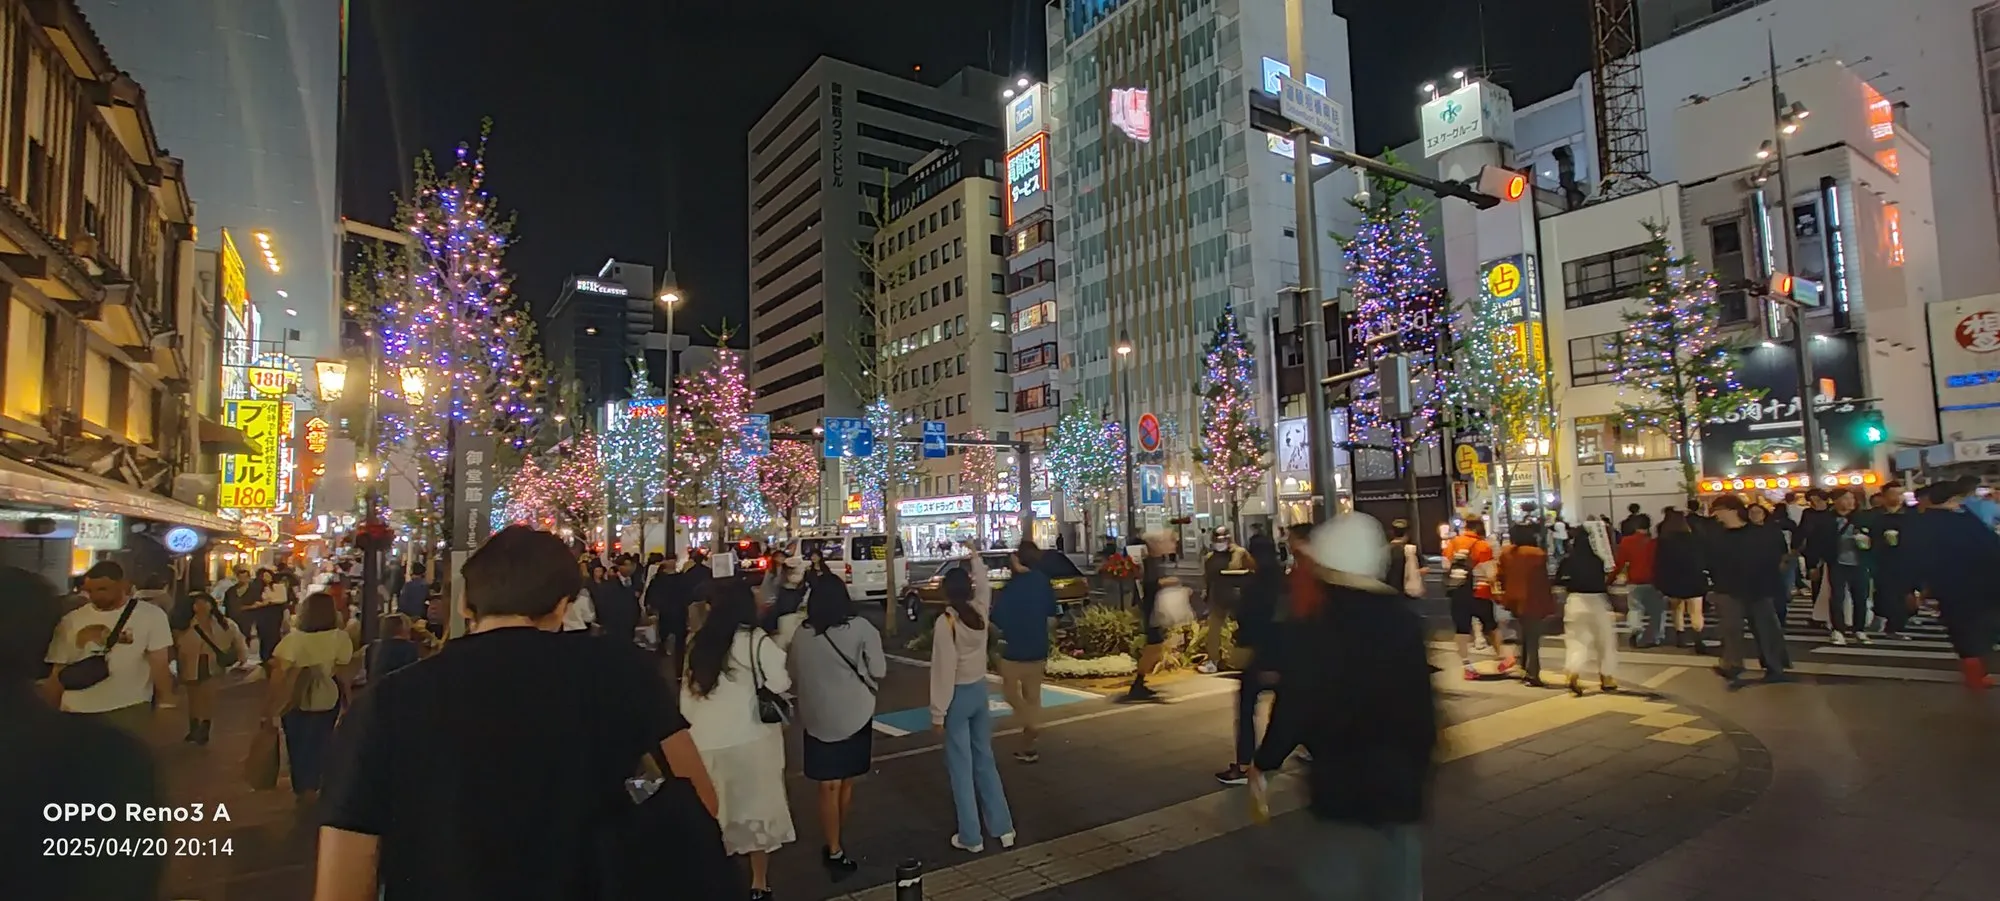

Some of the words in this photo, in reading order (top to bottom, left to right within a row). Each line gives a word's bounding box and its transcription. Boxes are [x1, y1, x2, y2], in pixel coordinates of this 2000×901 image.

[1012, 178, 1040, 203] サービス
[598, 286, 628, 296] CLASSIC
[1493, 265, 1514, 295] 占
[1460, 448, 1474, 470] 占
[465, 450, 483, 502] 御堂筋
[923, 501, 957, 513] スギドラッグ
